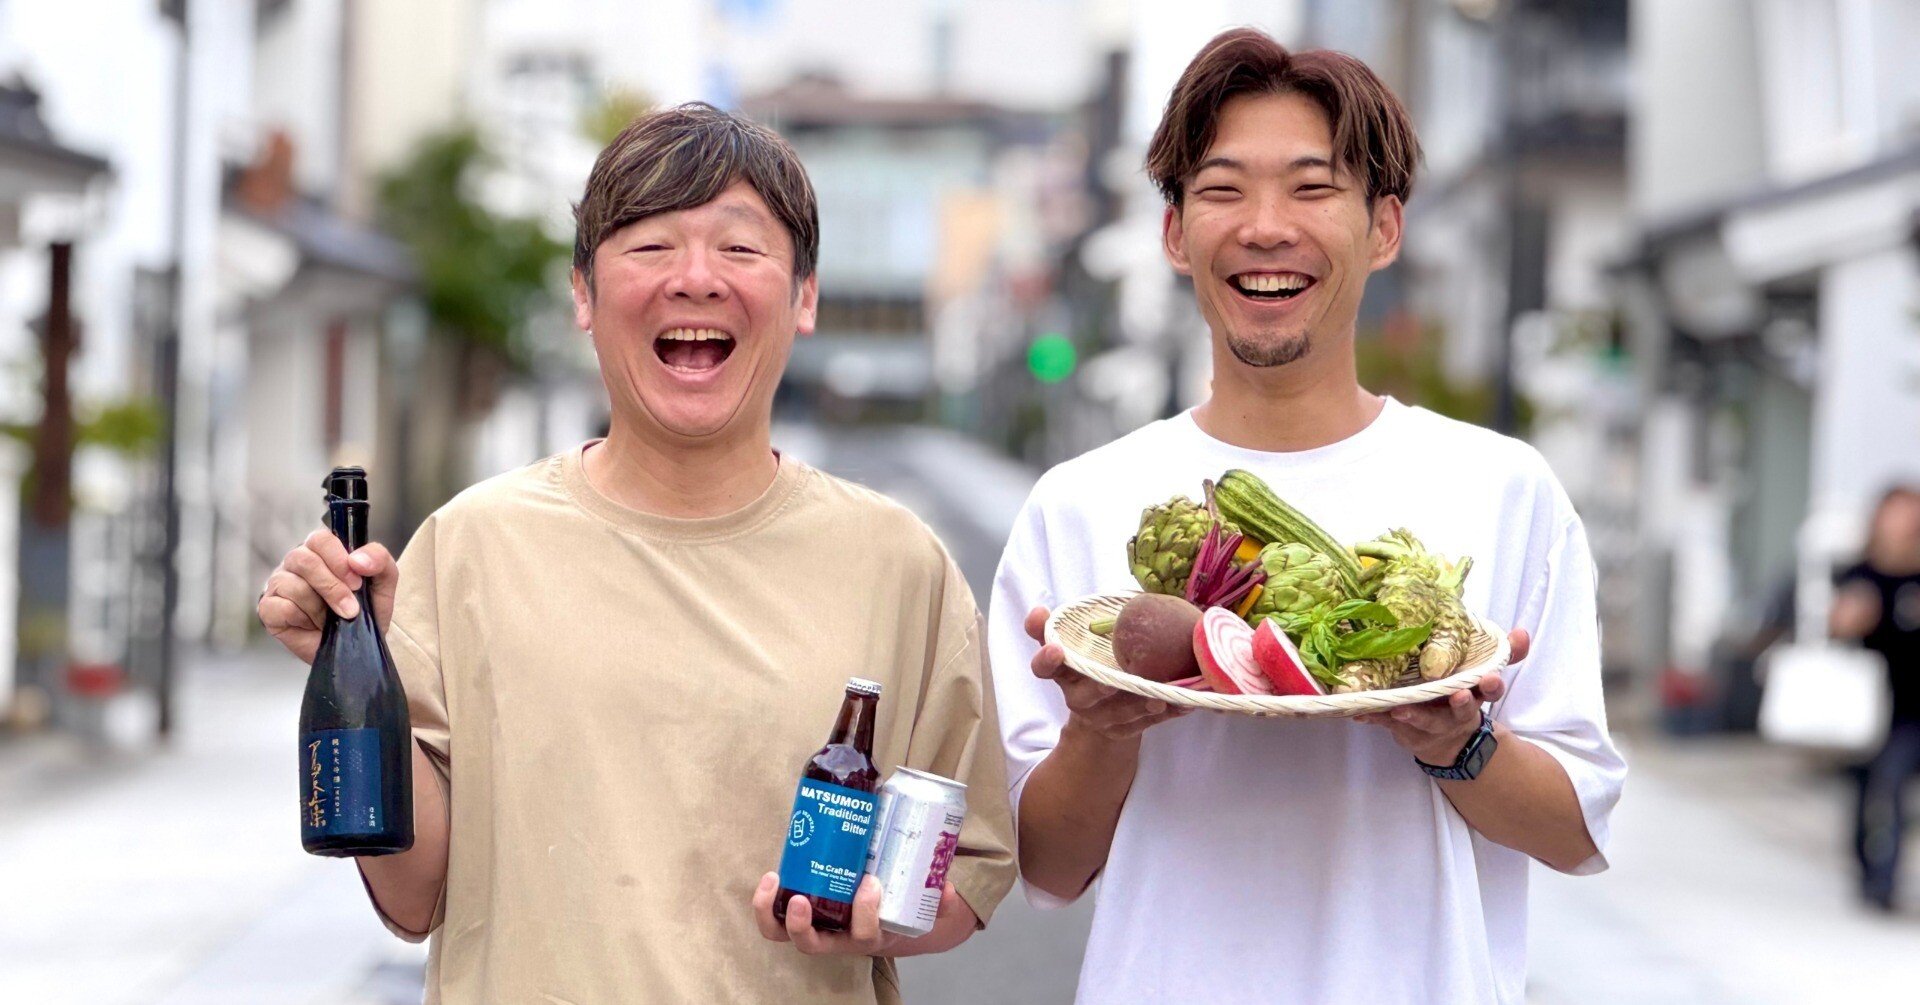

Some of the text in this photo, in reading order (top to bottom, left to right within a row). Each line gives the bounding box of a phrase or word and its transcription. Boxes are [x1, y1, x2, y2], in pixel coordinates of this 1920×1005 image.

[801, 786, 873, 812] MATSUMOTO
[817, 802, 871, 825] Traditional
[841, 821, 867, 836] Bitter
[810, 860, 825, 871] The
[825, 864, 844, 875] Craft
